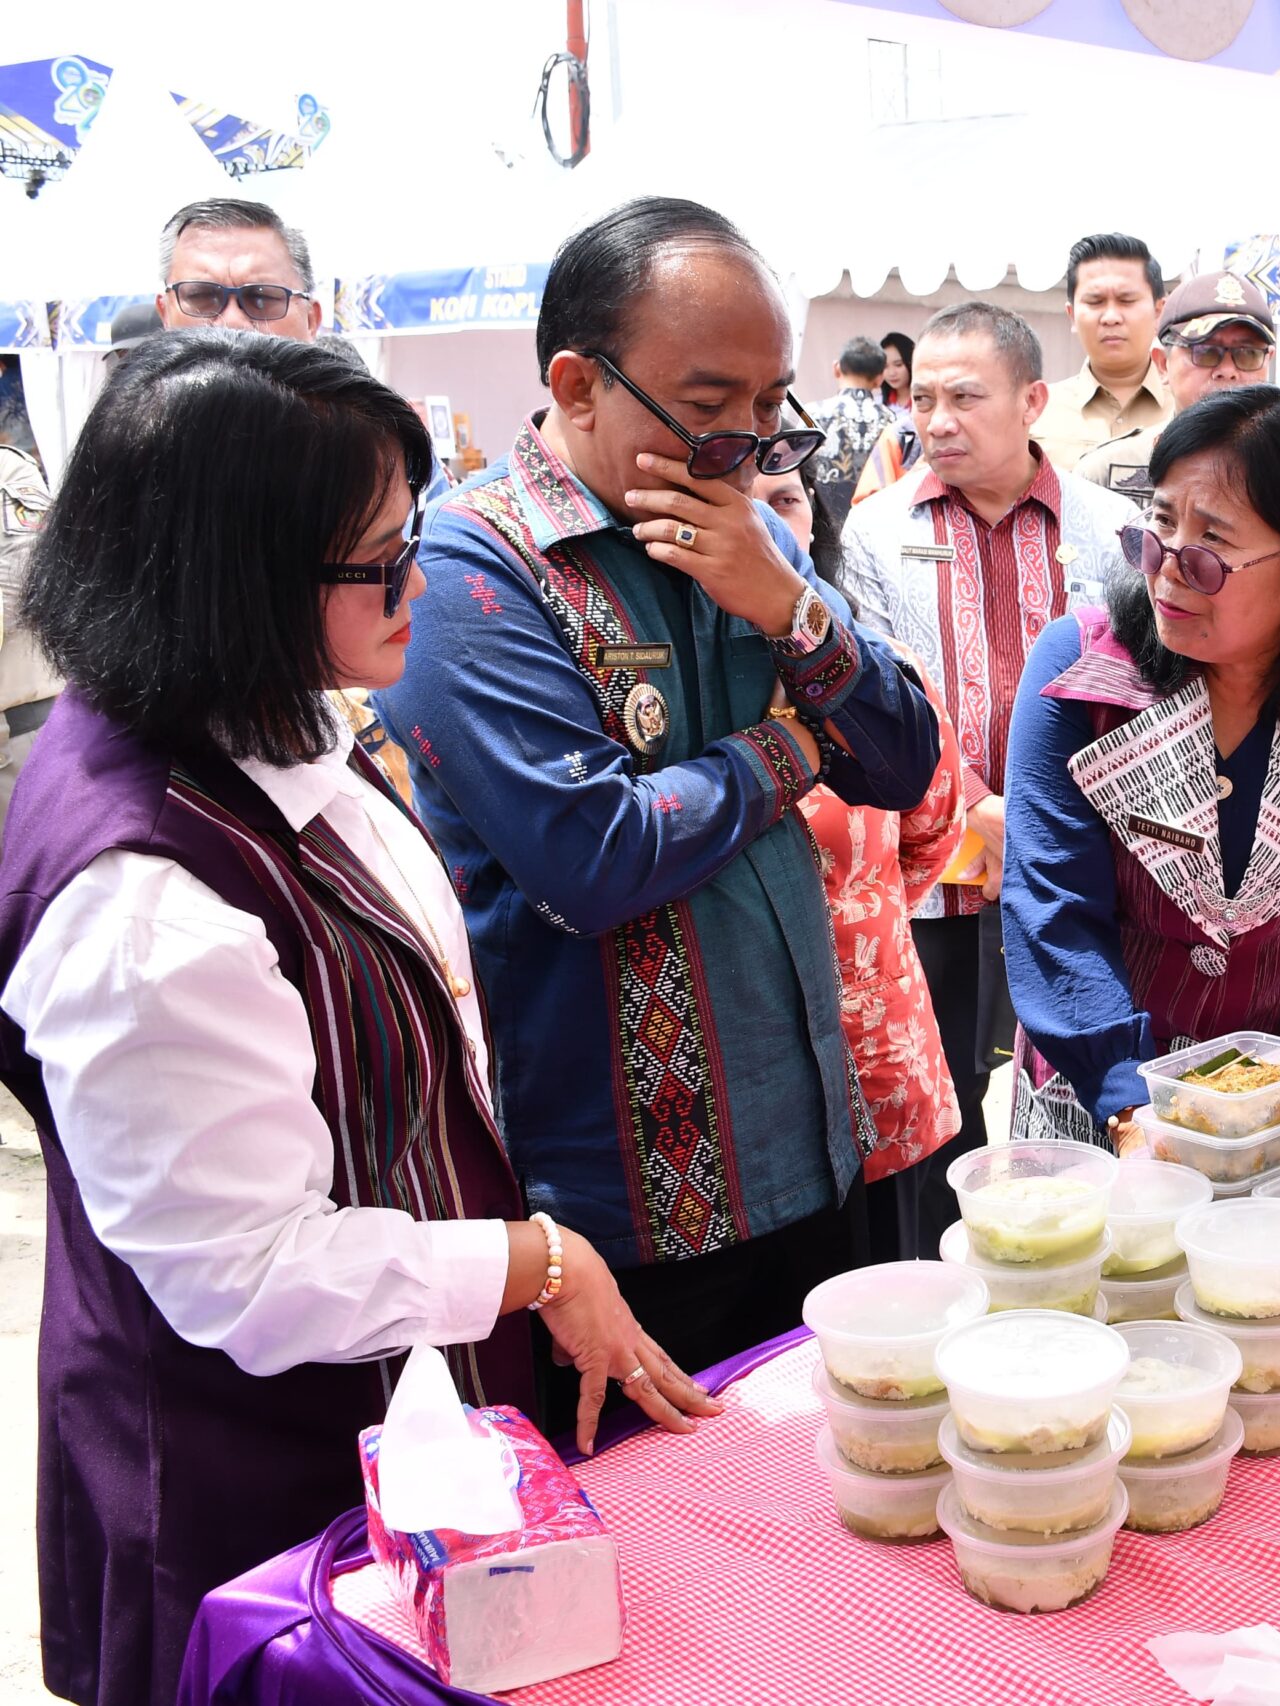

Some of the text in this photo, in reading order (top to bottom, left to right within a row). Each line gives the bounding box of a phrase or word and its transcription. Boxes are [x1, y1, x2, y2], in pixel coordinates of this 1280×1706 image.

[484, 265, 528, 289] STAND
[605, 651, 629, 660] ARISTON
[1137, 821, 1196, 848] TETTI NAIBAHO
